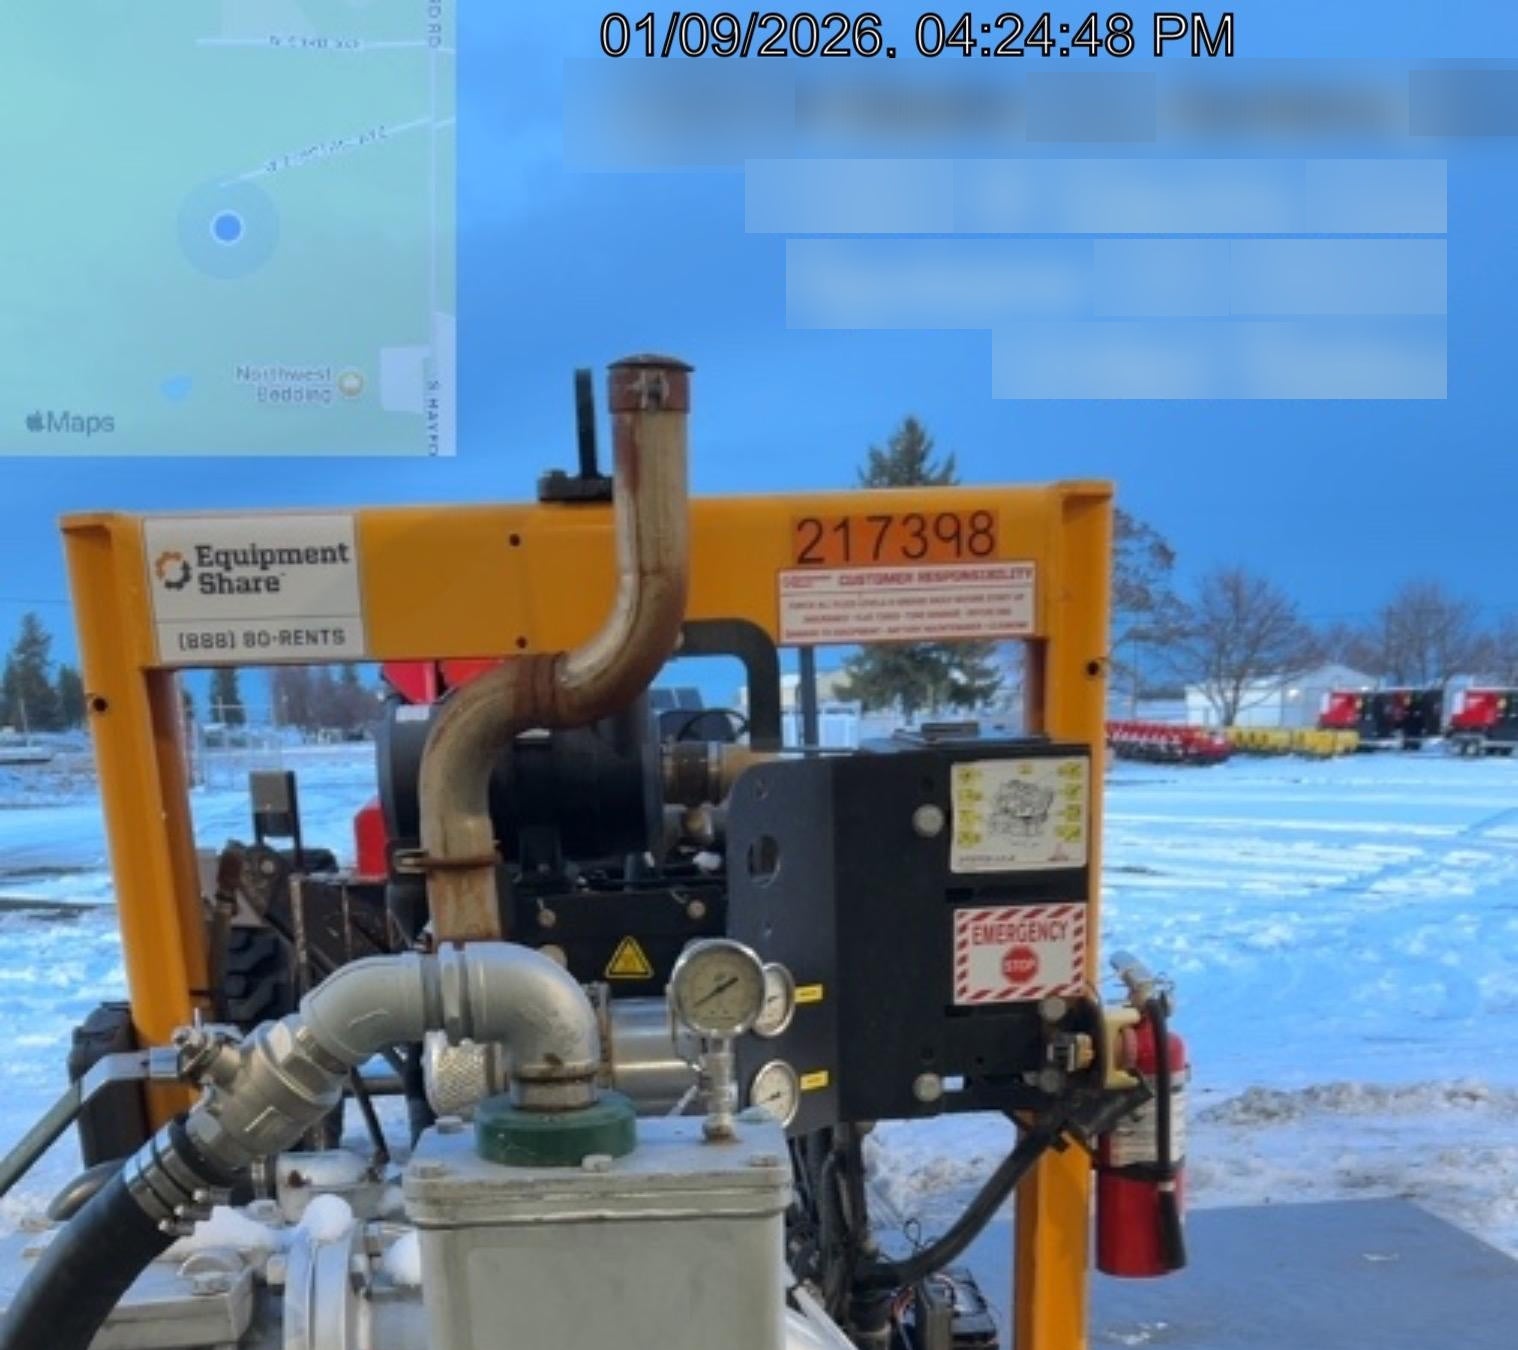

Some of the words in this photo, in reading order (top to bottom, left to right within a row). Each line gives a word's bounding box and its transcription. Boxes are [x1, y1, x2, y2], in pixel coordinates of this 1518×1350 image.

[797, 510, 996, 564] 217398
[195, 543, 350, 571] Equipment
[199, 572, 281, 595] Share
[178, 632, 236, 651] (888)
[972, 921, 1069, 945] EMERGENCY
[1003, 958, 1036, 974] STOP
